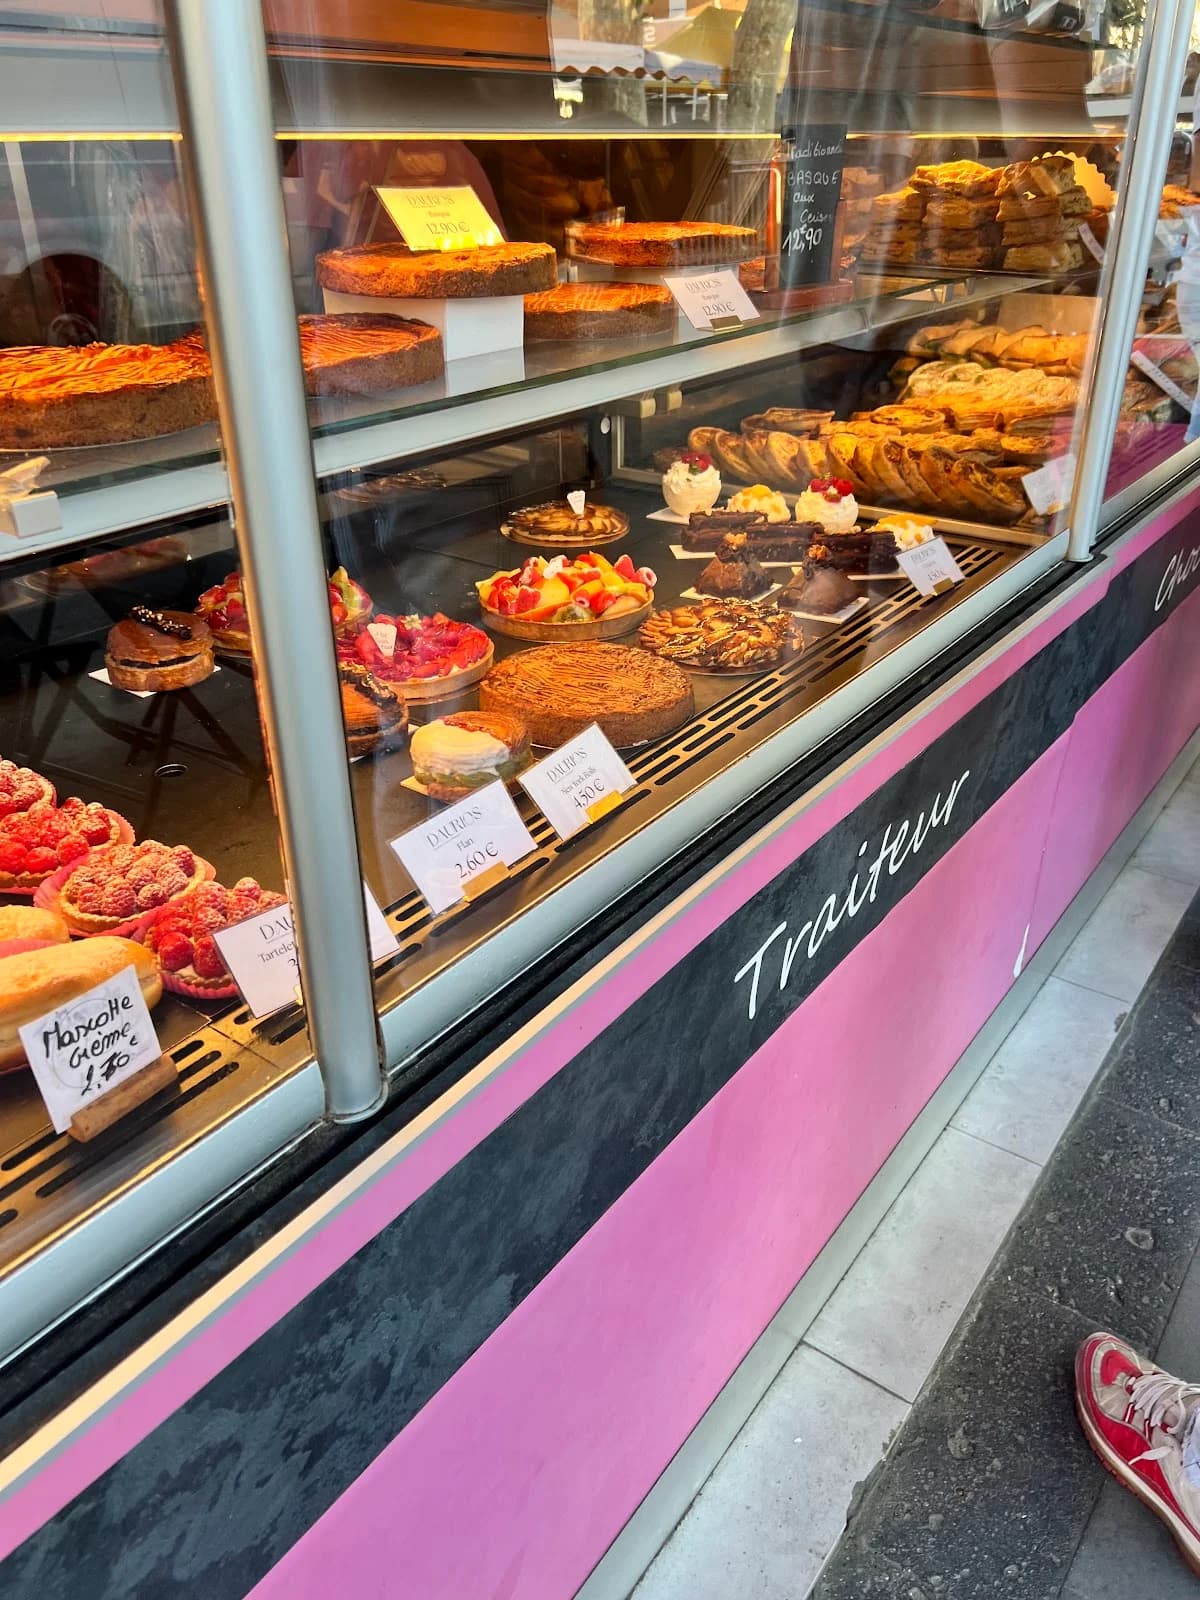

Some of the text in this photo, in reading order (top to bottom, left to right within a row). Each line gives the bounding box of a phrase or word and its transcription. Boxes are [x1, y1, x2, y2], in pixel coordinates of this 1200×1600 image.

[787, 170, 840, 186] BASQUE
[1154, 545, 1200, 611] Cha
[456, 838, 474, 851] Flan
[734, 770, 969, 1019] Traiteur
